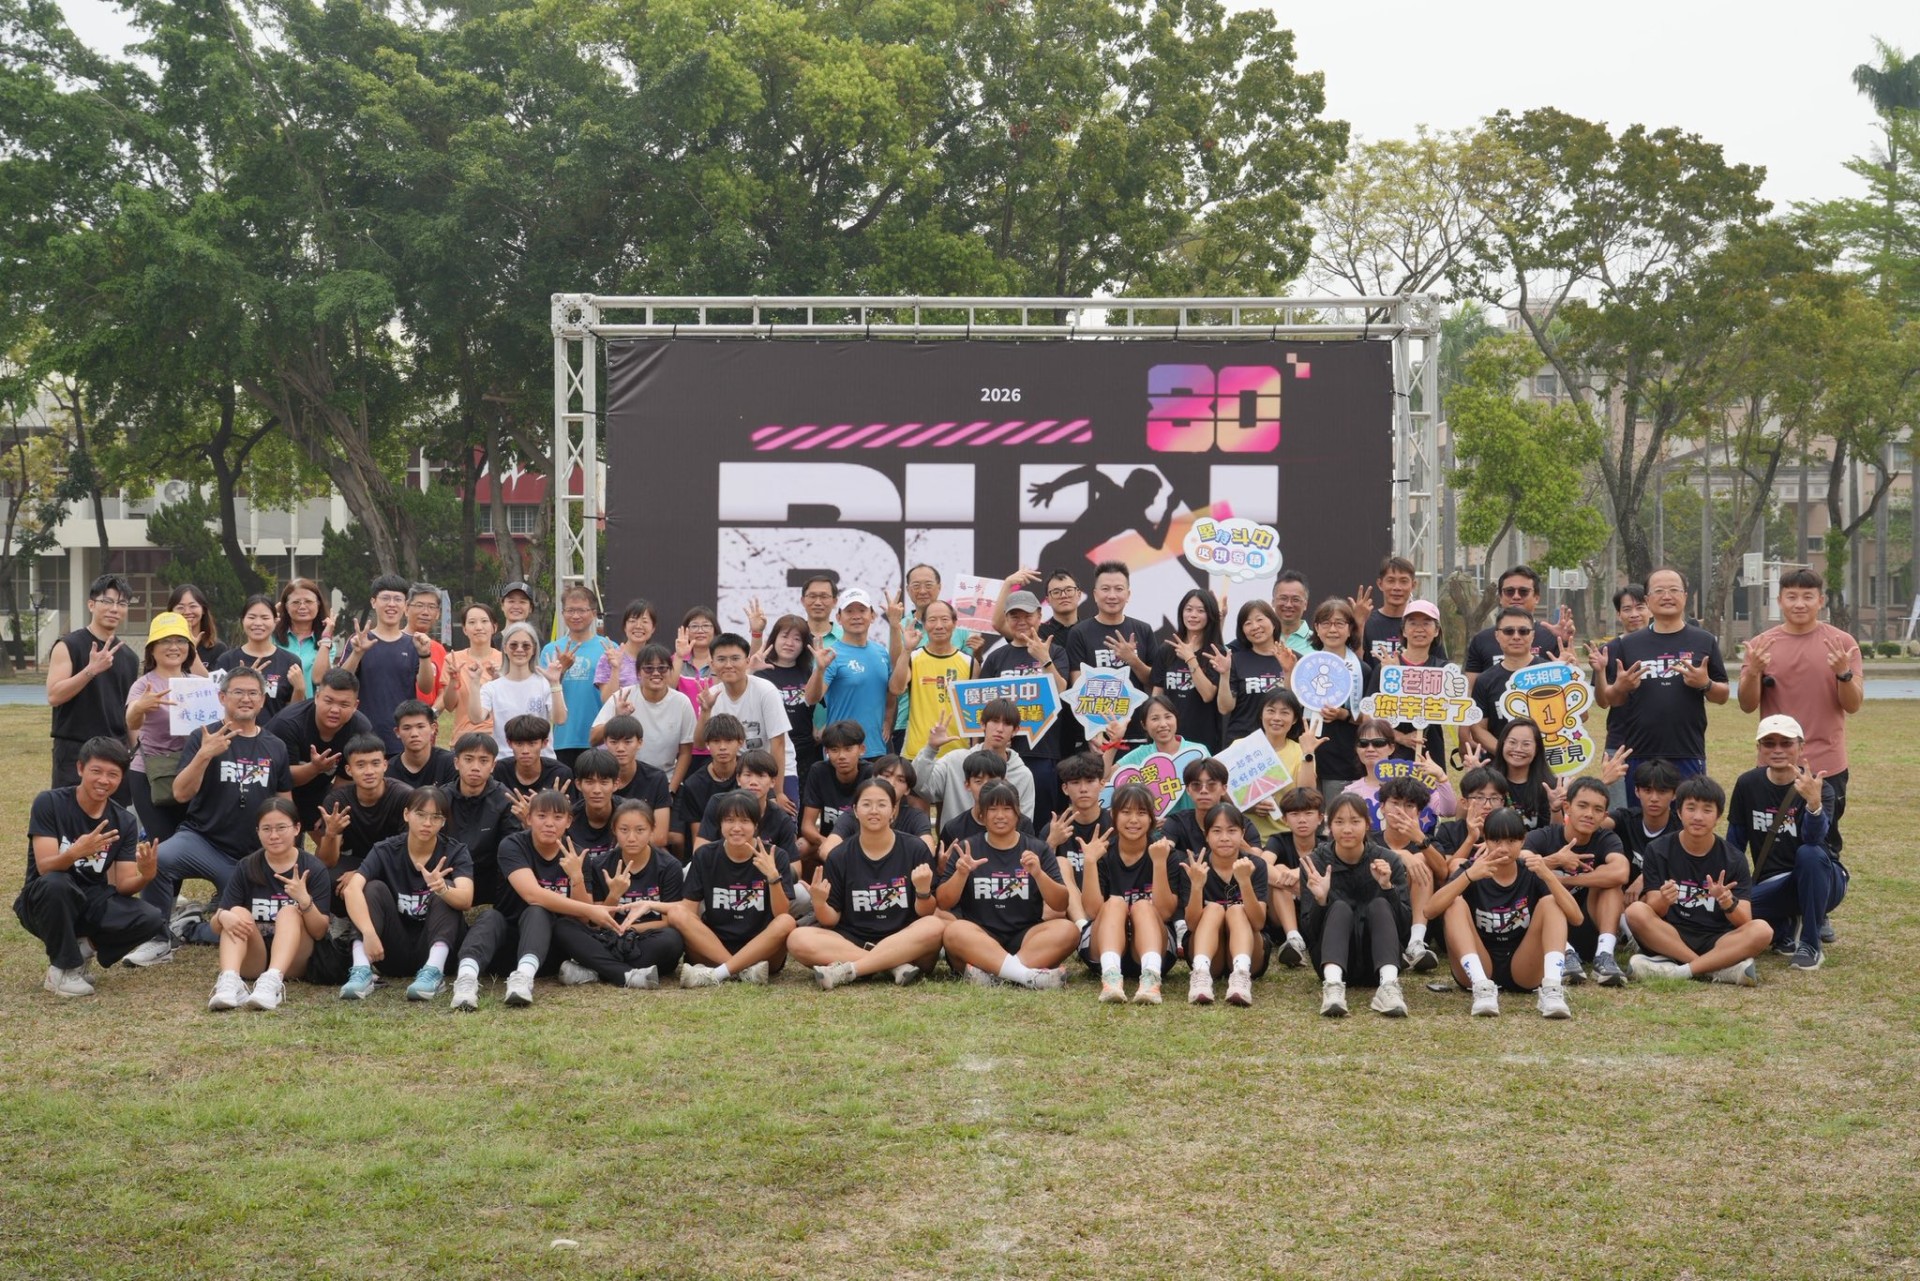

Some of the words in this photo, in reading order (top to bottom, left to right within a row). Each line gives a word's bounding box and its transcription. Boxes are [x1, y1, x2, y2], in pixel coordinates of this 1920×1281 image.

[981, 387, 1021, 403] 2026
[1146, 364, 1281, 453] 80
[1197, 522, 1275, 550] 堅持斗中
[1402, 669, 1443, 695] 老師
[1523, 668, 1562, 685] 先相信
[964, 683, 1039, 705] 優質斗中
[1086, 680, 1121, 697] 青春
[1075, 696, 1130, 715] 不散場
[1374, 695, 1472, 722] 您辛苦了
[1543, 704, 1556, 725] 1
[713, 887, 764, 911] RUN
[973, 877, 1030, 900] RUN
[852, 889, 908, 912] RUN
